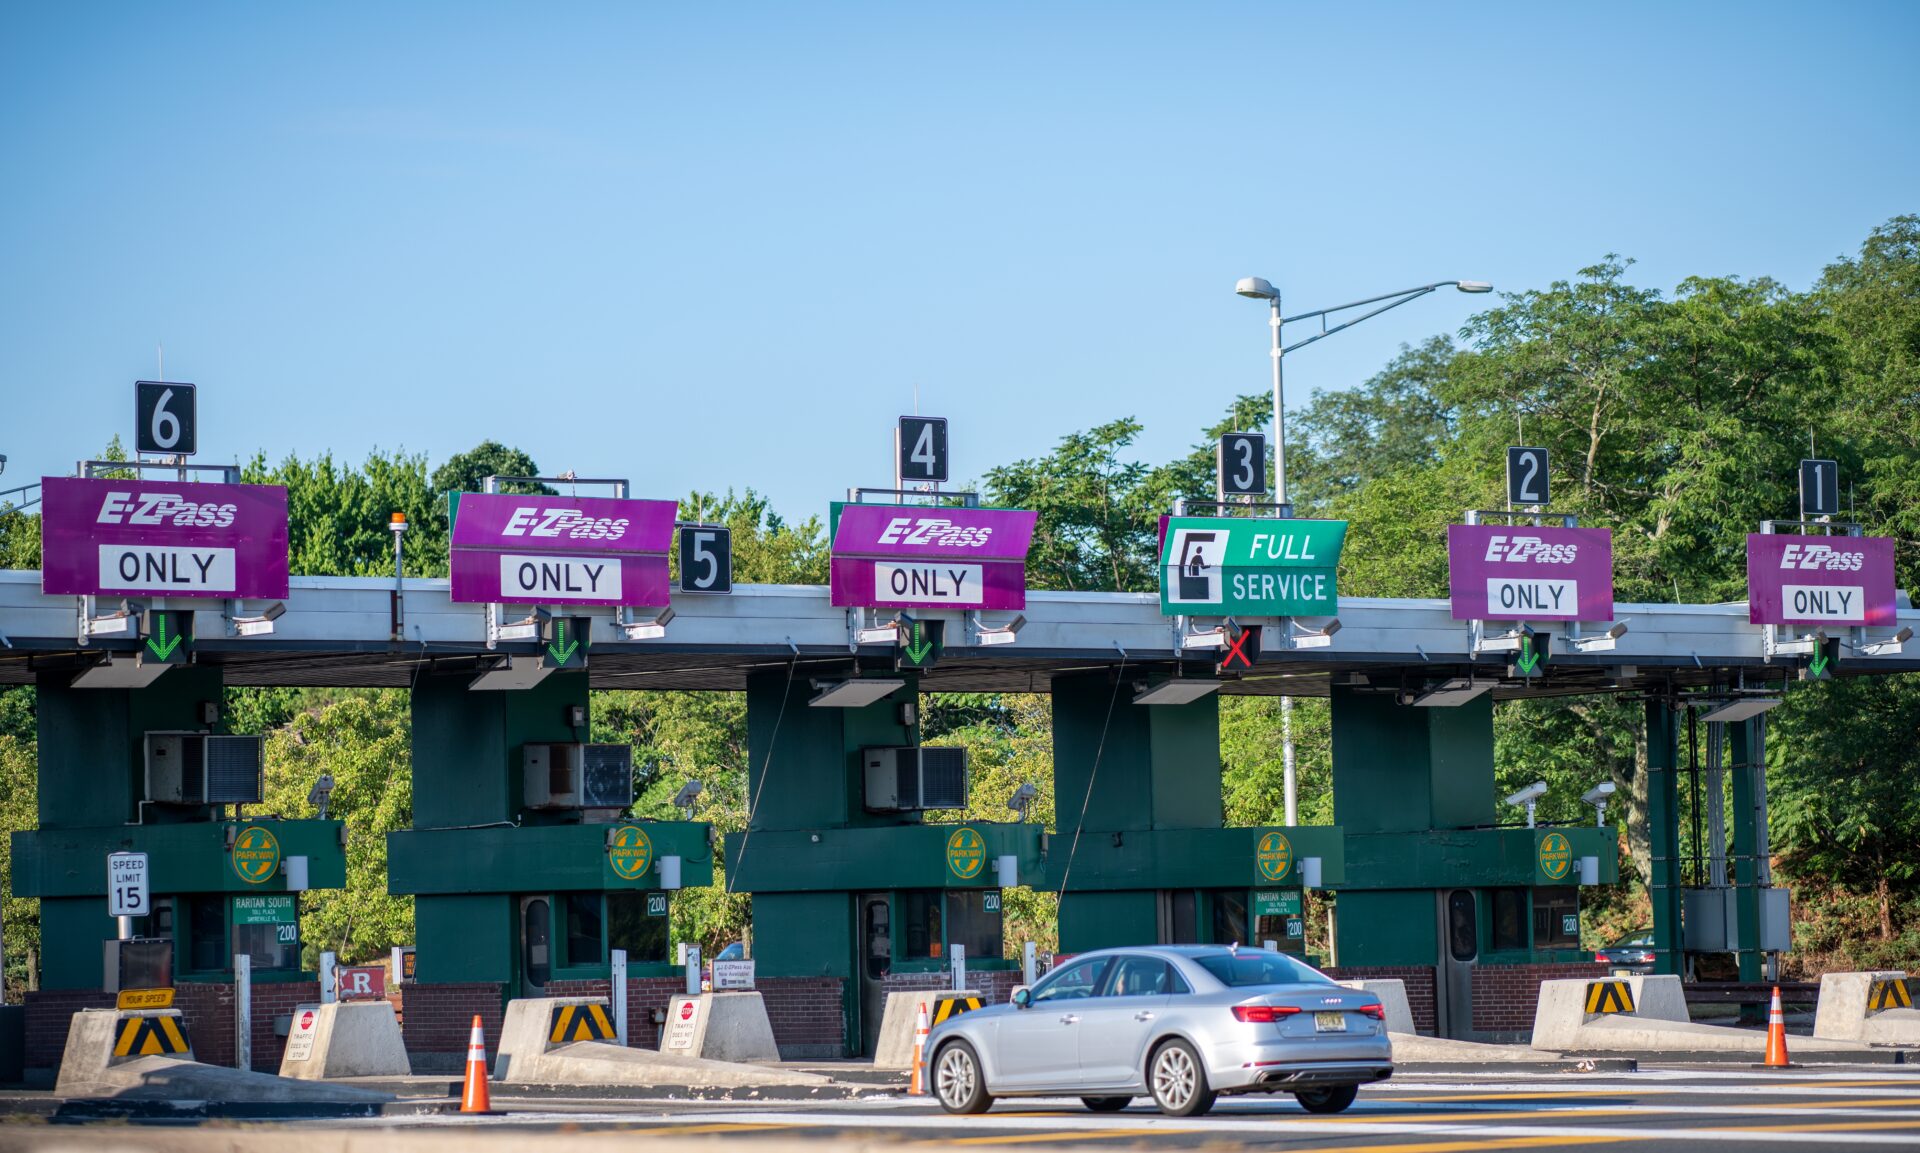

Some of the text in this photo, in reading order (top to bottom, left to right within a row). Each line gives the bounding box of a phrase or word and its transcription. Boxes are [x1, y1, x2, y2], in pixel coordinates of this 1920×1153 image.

[152, 388, 180, 448] 6
[910, 422, 936, 476] 4
[1233, 438, 1254, 490] 3
[1518, 452, 1539, 500] 2
[1814, 464, 1822, 510] 1
[96, 492, 237, 528] E-ZPass
[502, 507, 630, 540] E-ZPass
[876, 518, 992, 547] E-ZPass
[694, 532, 718, 588] 5
[1250, 534, 1315, 560] FULL
[1484, 536, 1578, 564] E-ZPass
[1780, 544, 1864, 572] E-ZPass
[119, 552, 216, 583] ONLY
[518, 562, 604, 592] ONLY
[891, 568, 967, 596] ONLY
[1232, 574, 1327, 600] SERVICE
[1500, 584, 1564, 610] ONLY
[1794, 590, 1852, 614] ONLY
[113, 860, 144, 870] SPEED
[236, 851, 274, 860] PARKWAY
[612, 849, 648, 857] PARKWAY
[1260, 852, 1288, 860] PARKWAY
[1541, 852, 1568, 860] PARKWAY
[116, 874, 141, 883] LIMIT
[116, 887, 141, 909] 15
[236, 897, 291, 908] RARITAN SOUTH
[1257, 892, 1299, 902] RARITAN SOUTH
[353, 973, 372, 993] R
[126, 994, 166, 1004] YOUR SPEED
